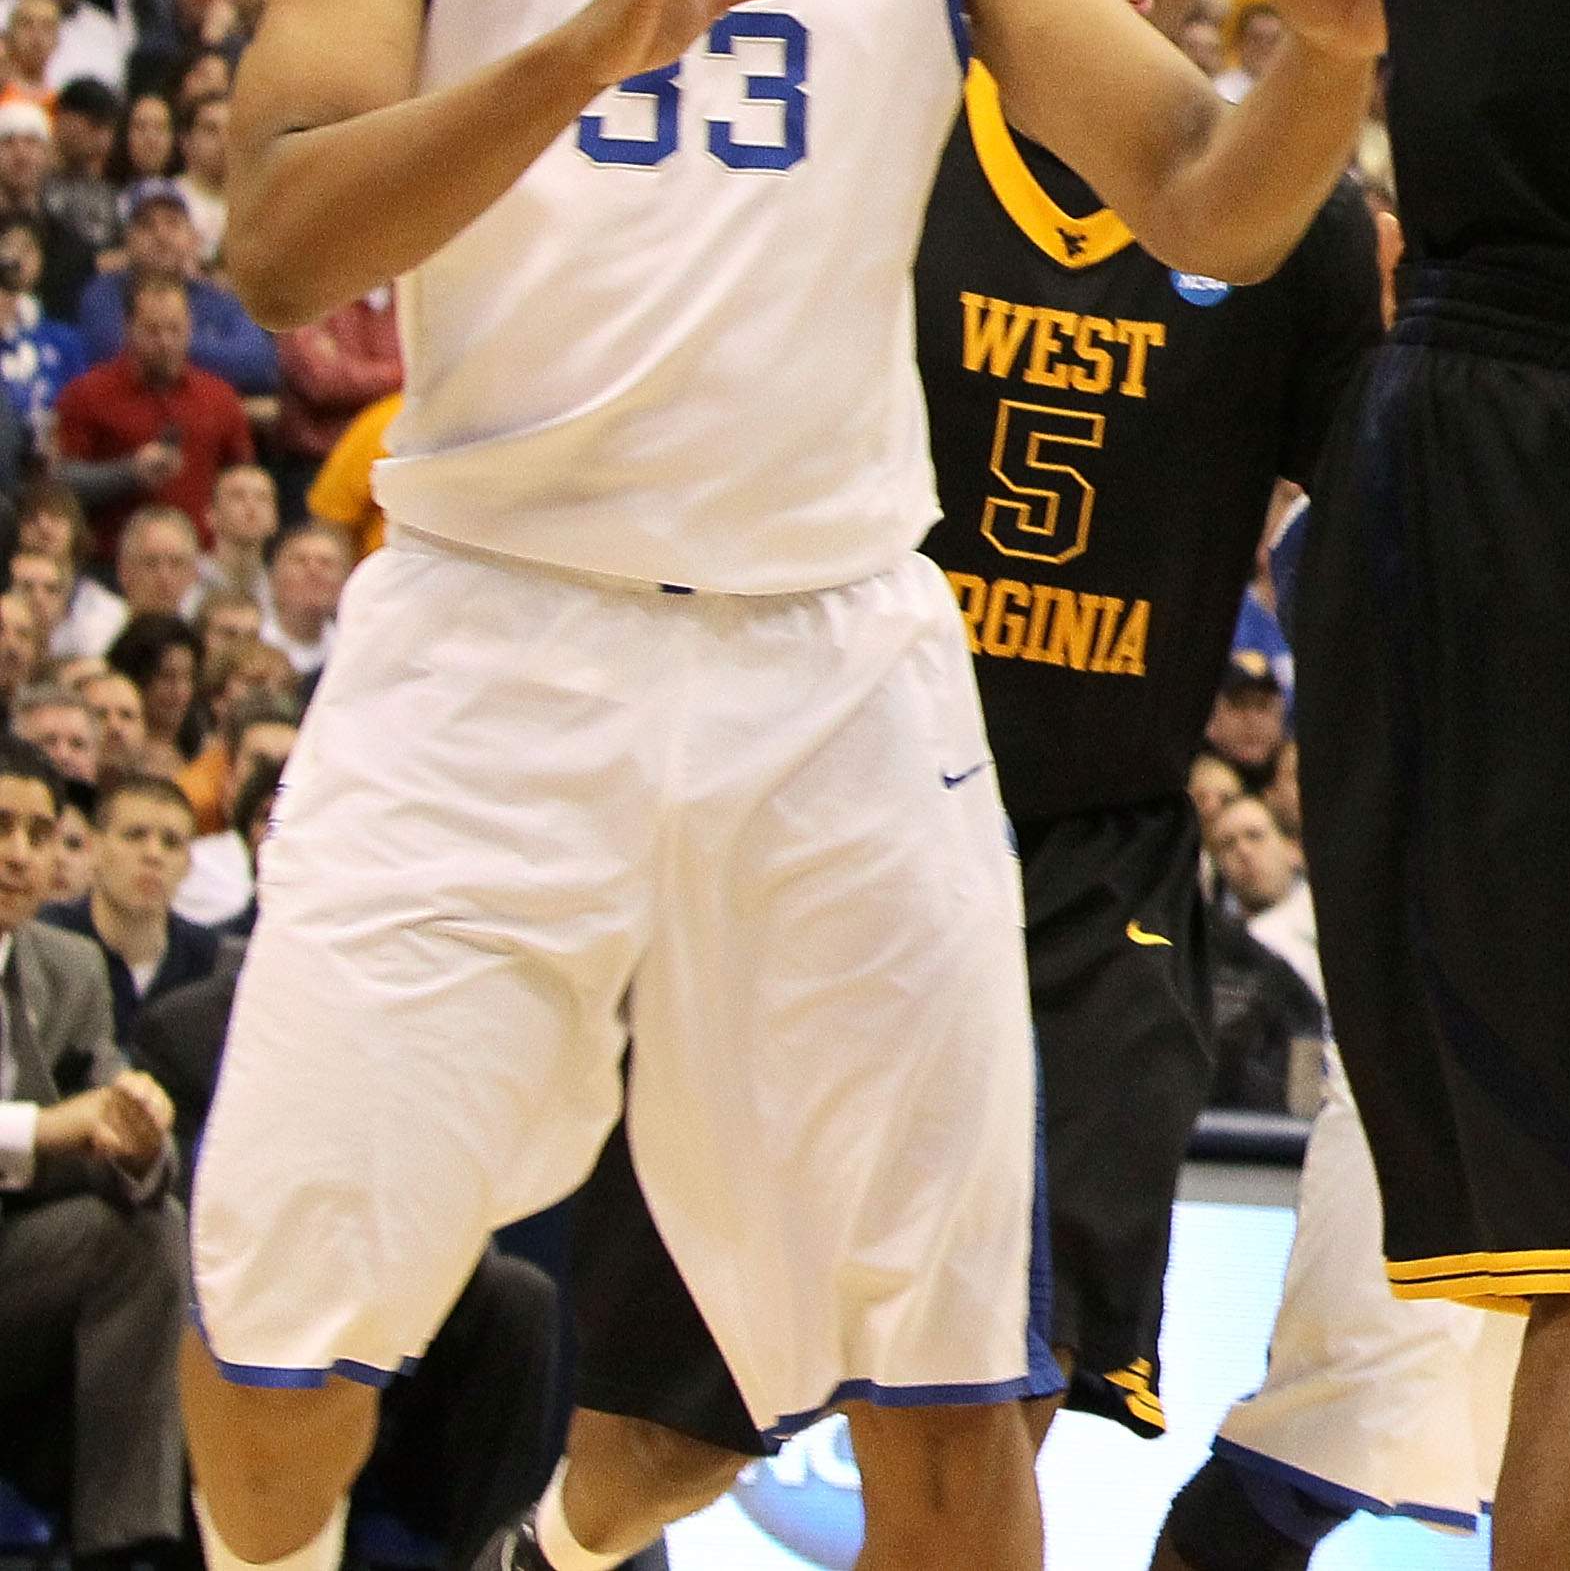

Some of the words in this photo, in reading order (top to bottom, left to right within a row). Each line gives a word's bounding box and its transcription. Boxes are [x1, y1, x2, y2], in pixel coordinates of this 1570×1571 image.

[959, 291, 1167, 398] WEST
[980, 398, 1106, 565] 5
[944, 570, 1151, 677] RGINIA
